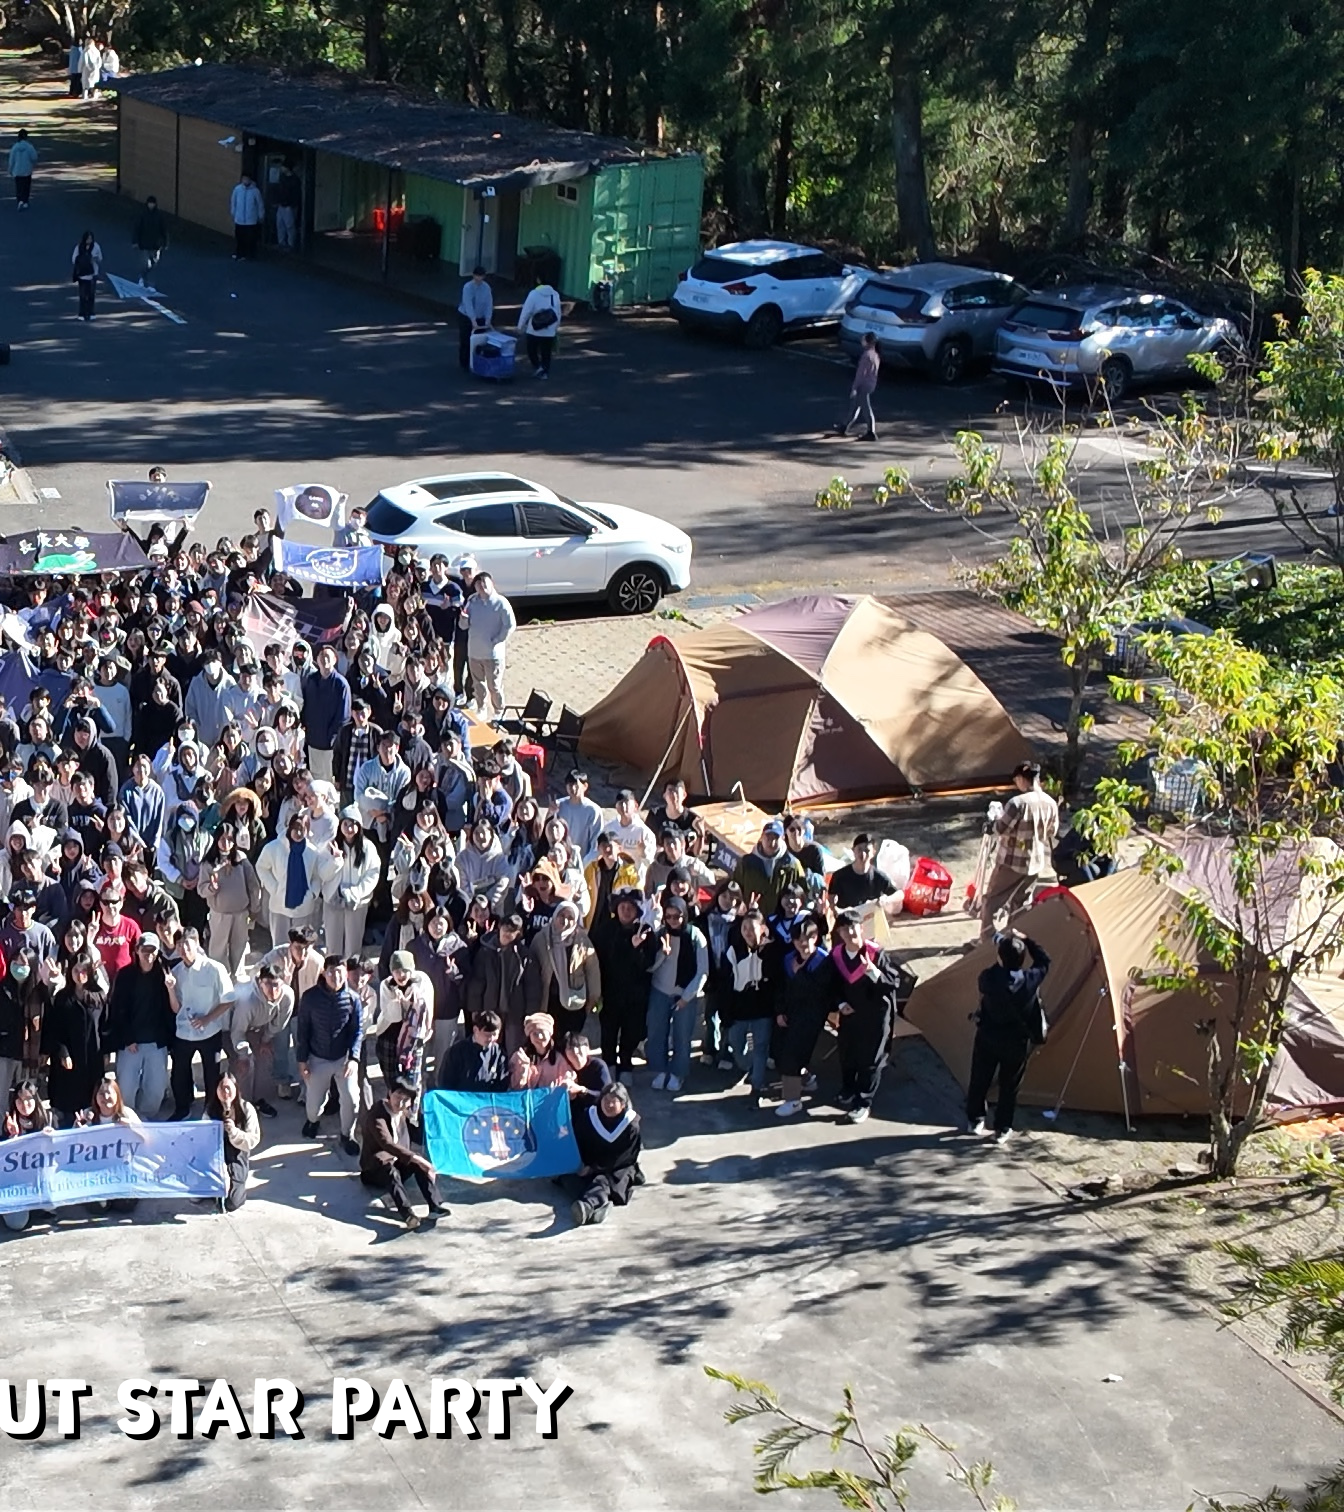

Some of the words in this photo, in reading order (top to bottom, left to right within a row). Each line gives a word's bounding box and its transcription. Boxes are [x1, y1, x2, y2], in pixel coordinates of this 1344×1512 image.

[3, 1150, 60, 1173] Star
[66, 1138, 141, 1166] Party
[48, 1171, 122, 1193] Universities
[125, 1172, 138, 1184] in
